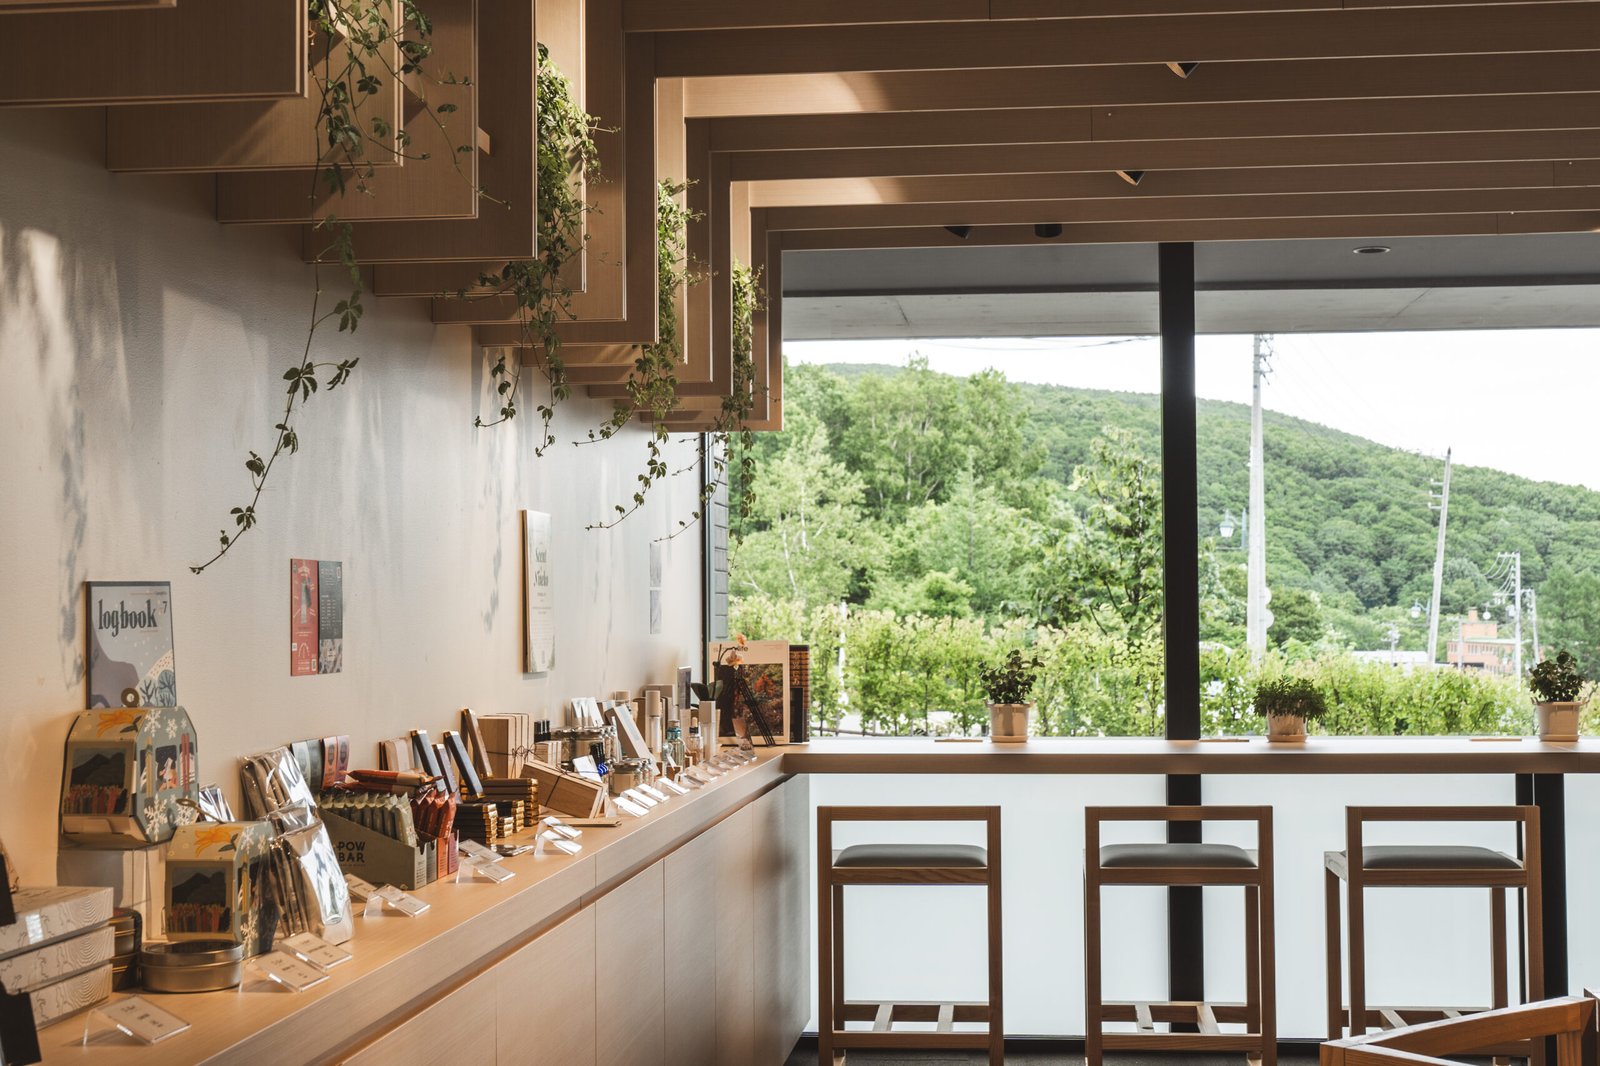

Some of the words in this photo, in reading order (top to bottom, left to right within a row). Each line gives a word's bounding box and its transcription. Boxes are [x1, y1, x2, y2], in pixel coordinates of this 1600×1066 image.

[98, 599, 158, 637] logbook
[337, 841, 366, 851] POW
[338, 852, 365, 863] BAR
